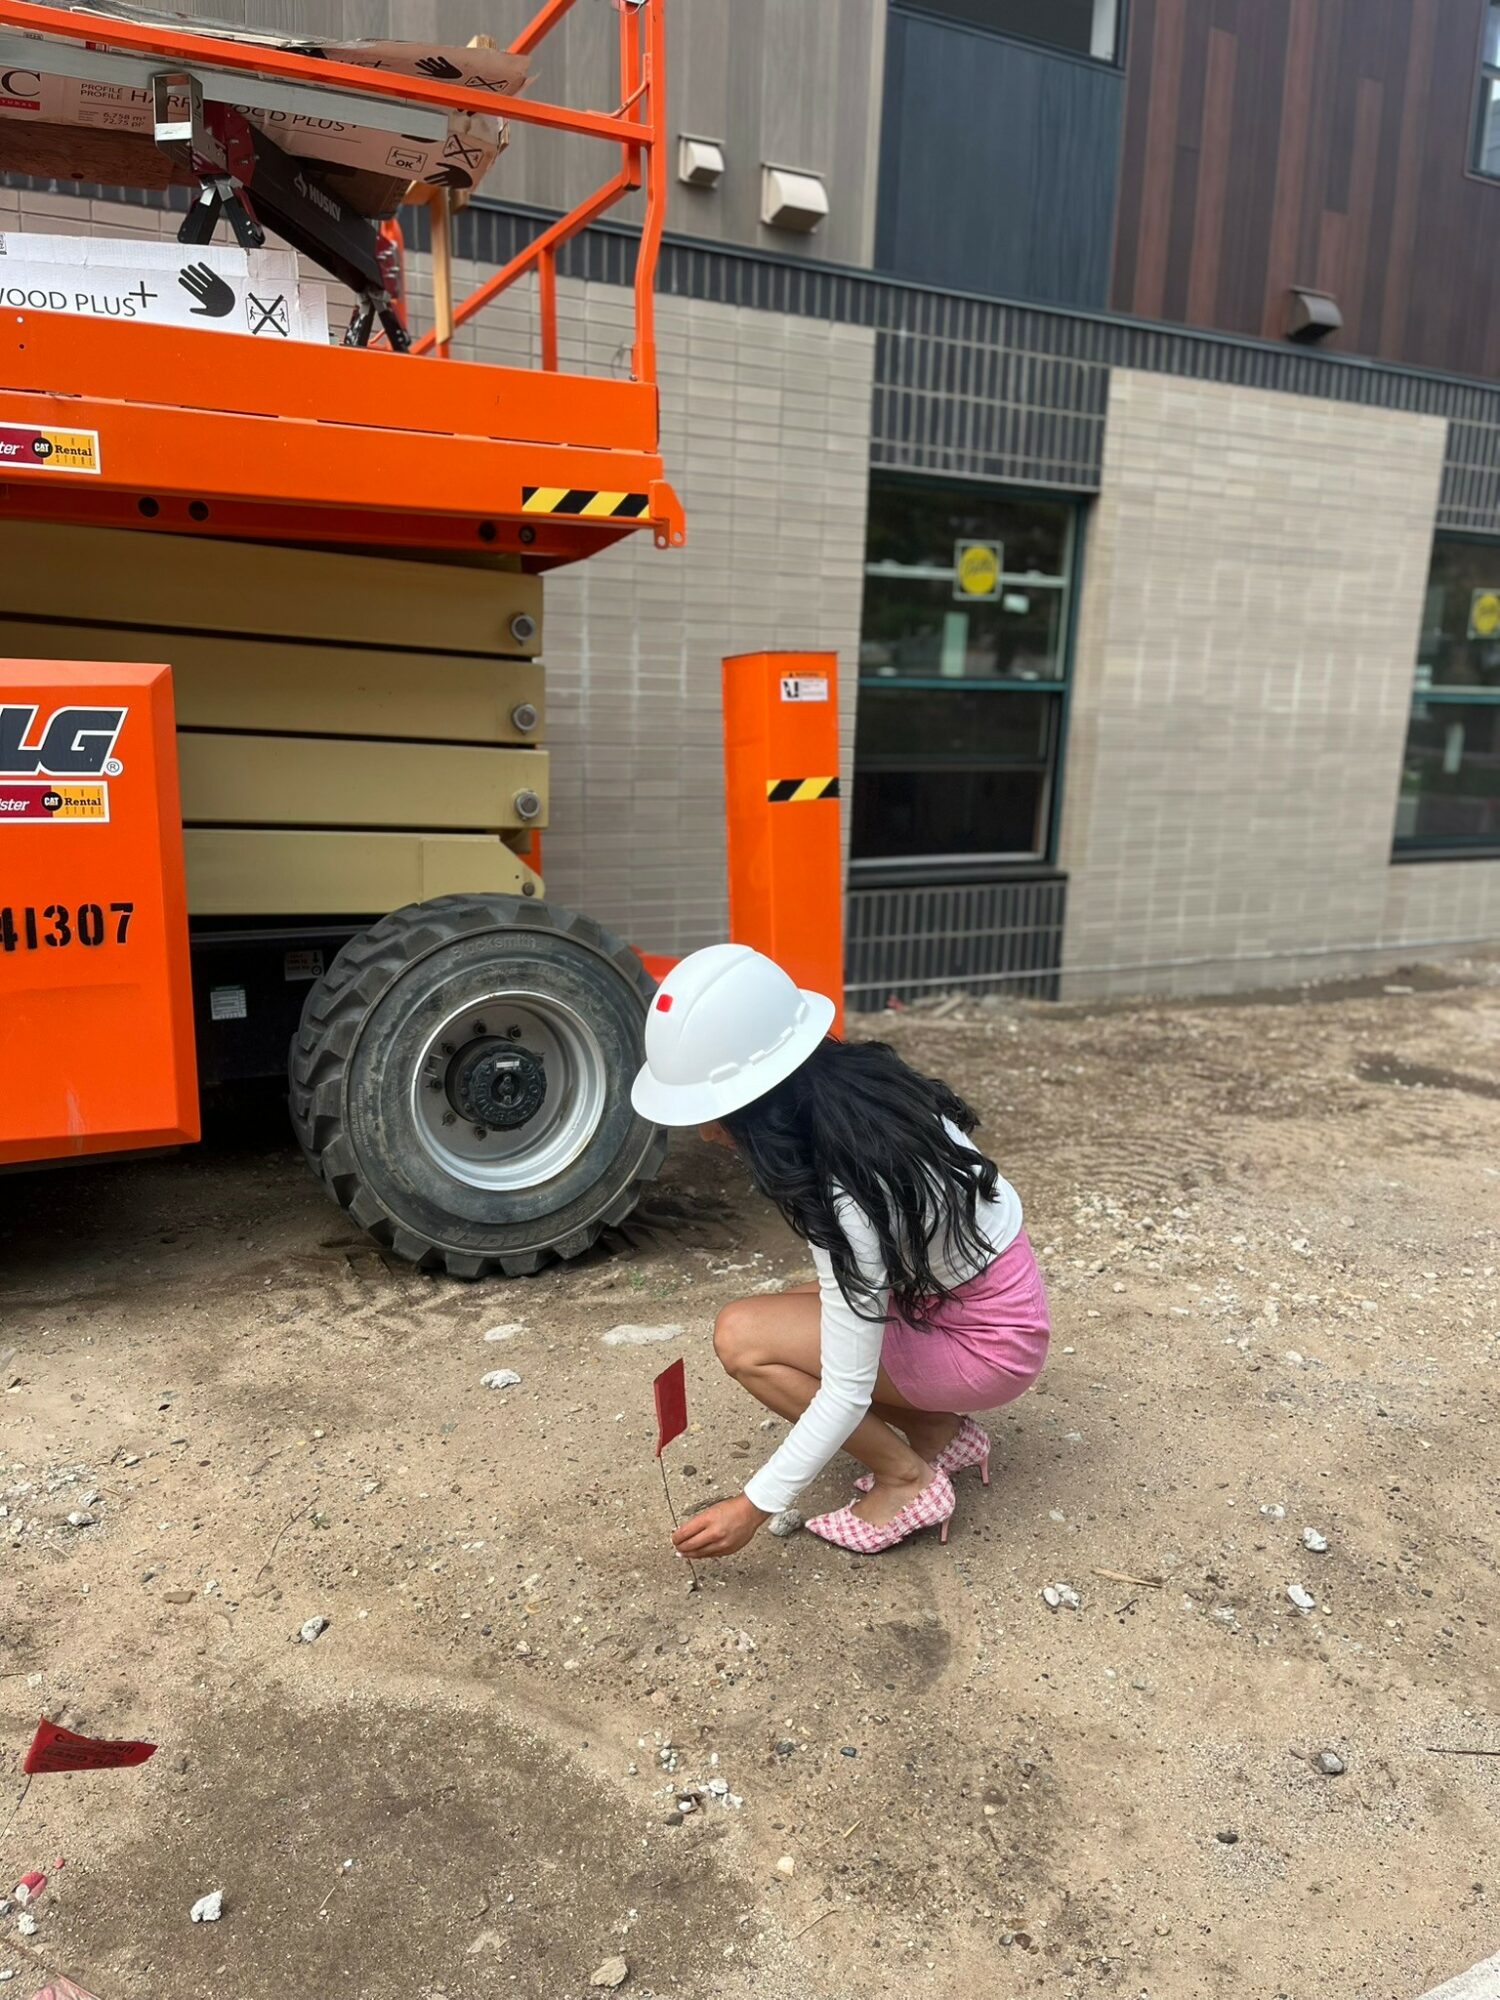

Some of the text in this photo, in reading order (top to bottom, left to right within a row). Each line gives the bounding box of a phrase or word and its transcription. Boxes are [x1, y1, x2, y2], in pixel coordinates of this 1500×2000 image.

[80, 89, 122, 101] PROFILE
[81, 83, 124, 95] PROFILE
[395, 159, 414, 169] OK
[308, 183, 342, 222] HUSKY
[34, 442, 50, 453] CAT
[55, 444, 92, 456] Rental
[0, 797, 102, 811] ster CAT Rental
[0, 902, 134, 952] 41307
[452, 933, 537, 961] Blacksmith
